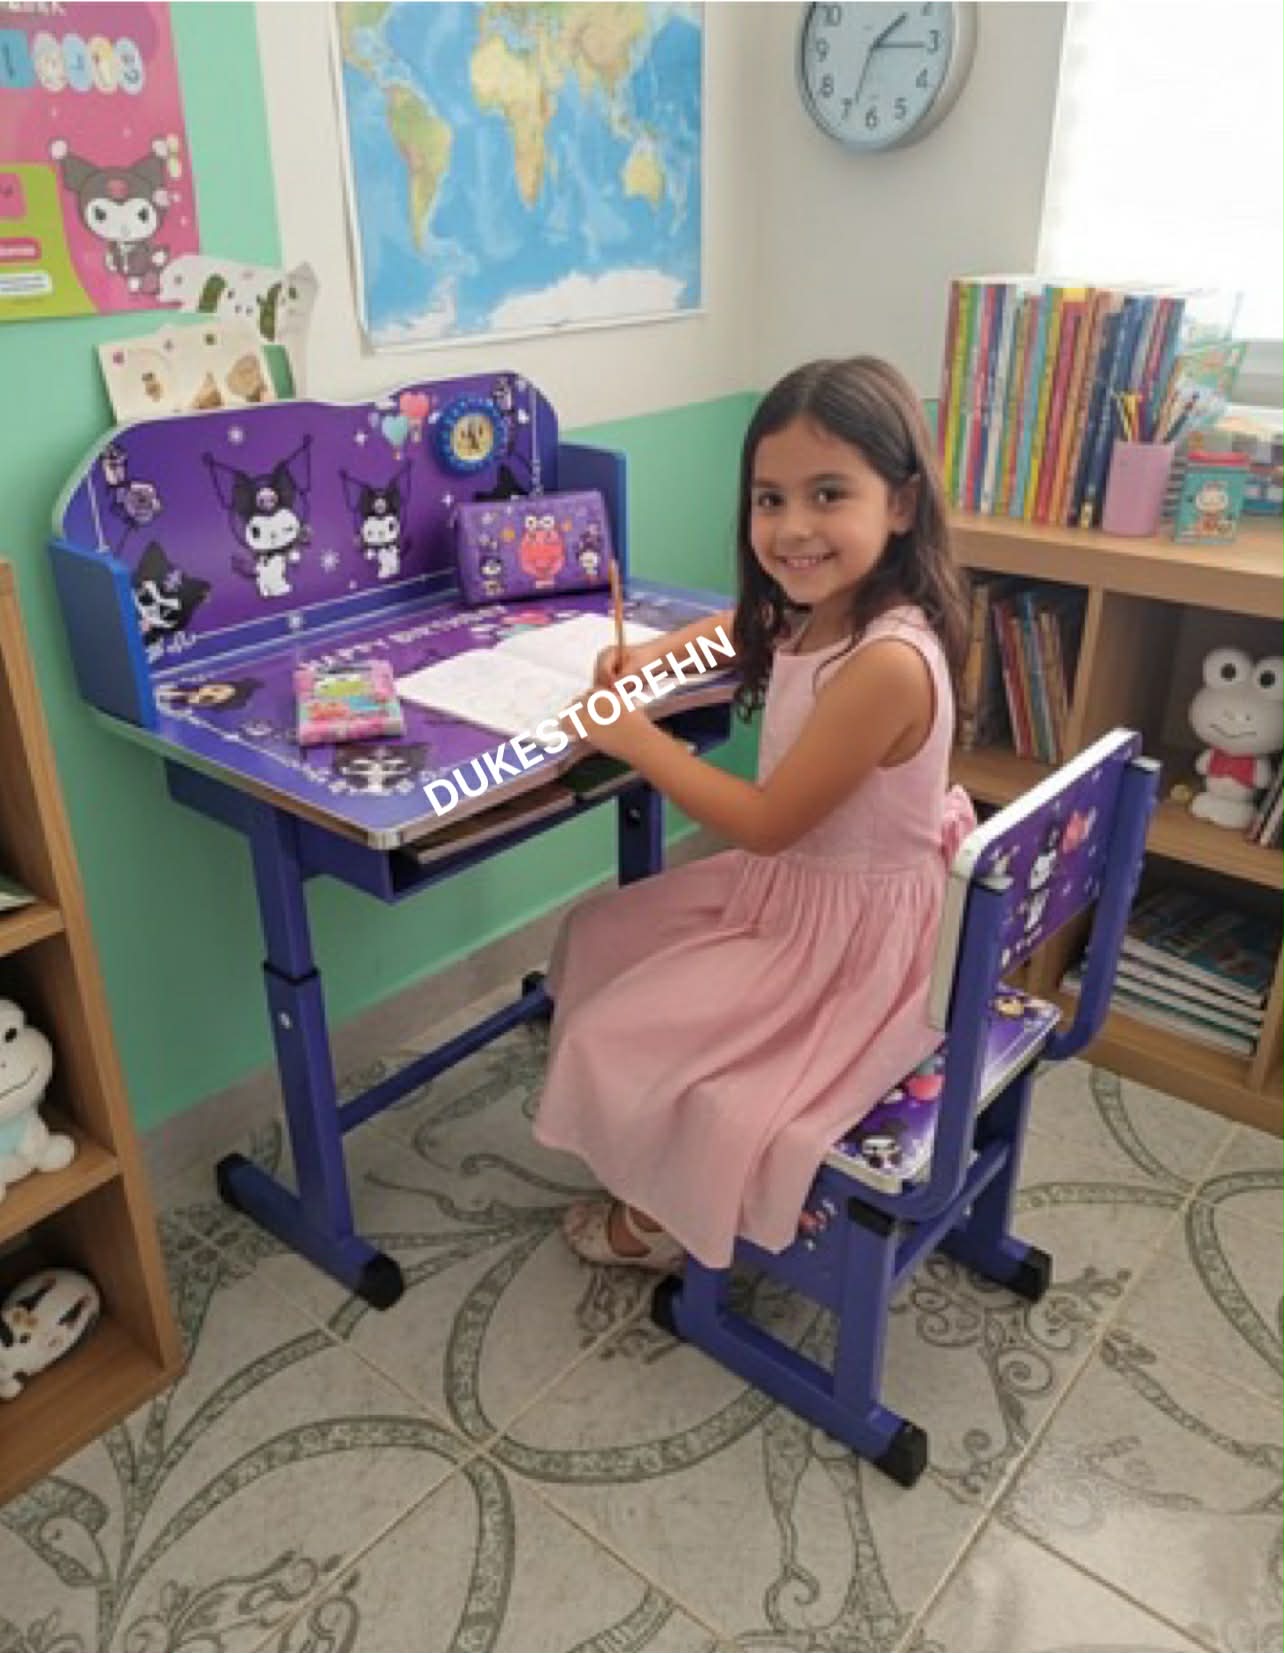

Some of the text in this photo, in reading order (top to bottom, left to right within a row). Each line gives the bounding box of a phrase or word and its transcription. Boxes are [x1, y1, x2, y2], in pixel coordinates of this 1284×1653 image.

[814, 38, 830, 62] 9
[927, 29, 941, 55] 3
[820, 75, 834, 98] 8
[915, 68, 928, 89] 4
[841, 98, 853, 120] 7
[865, 106, 878, 129] 6
[894, 97, 908, 120] 5
